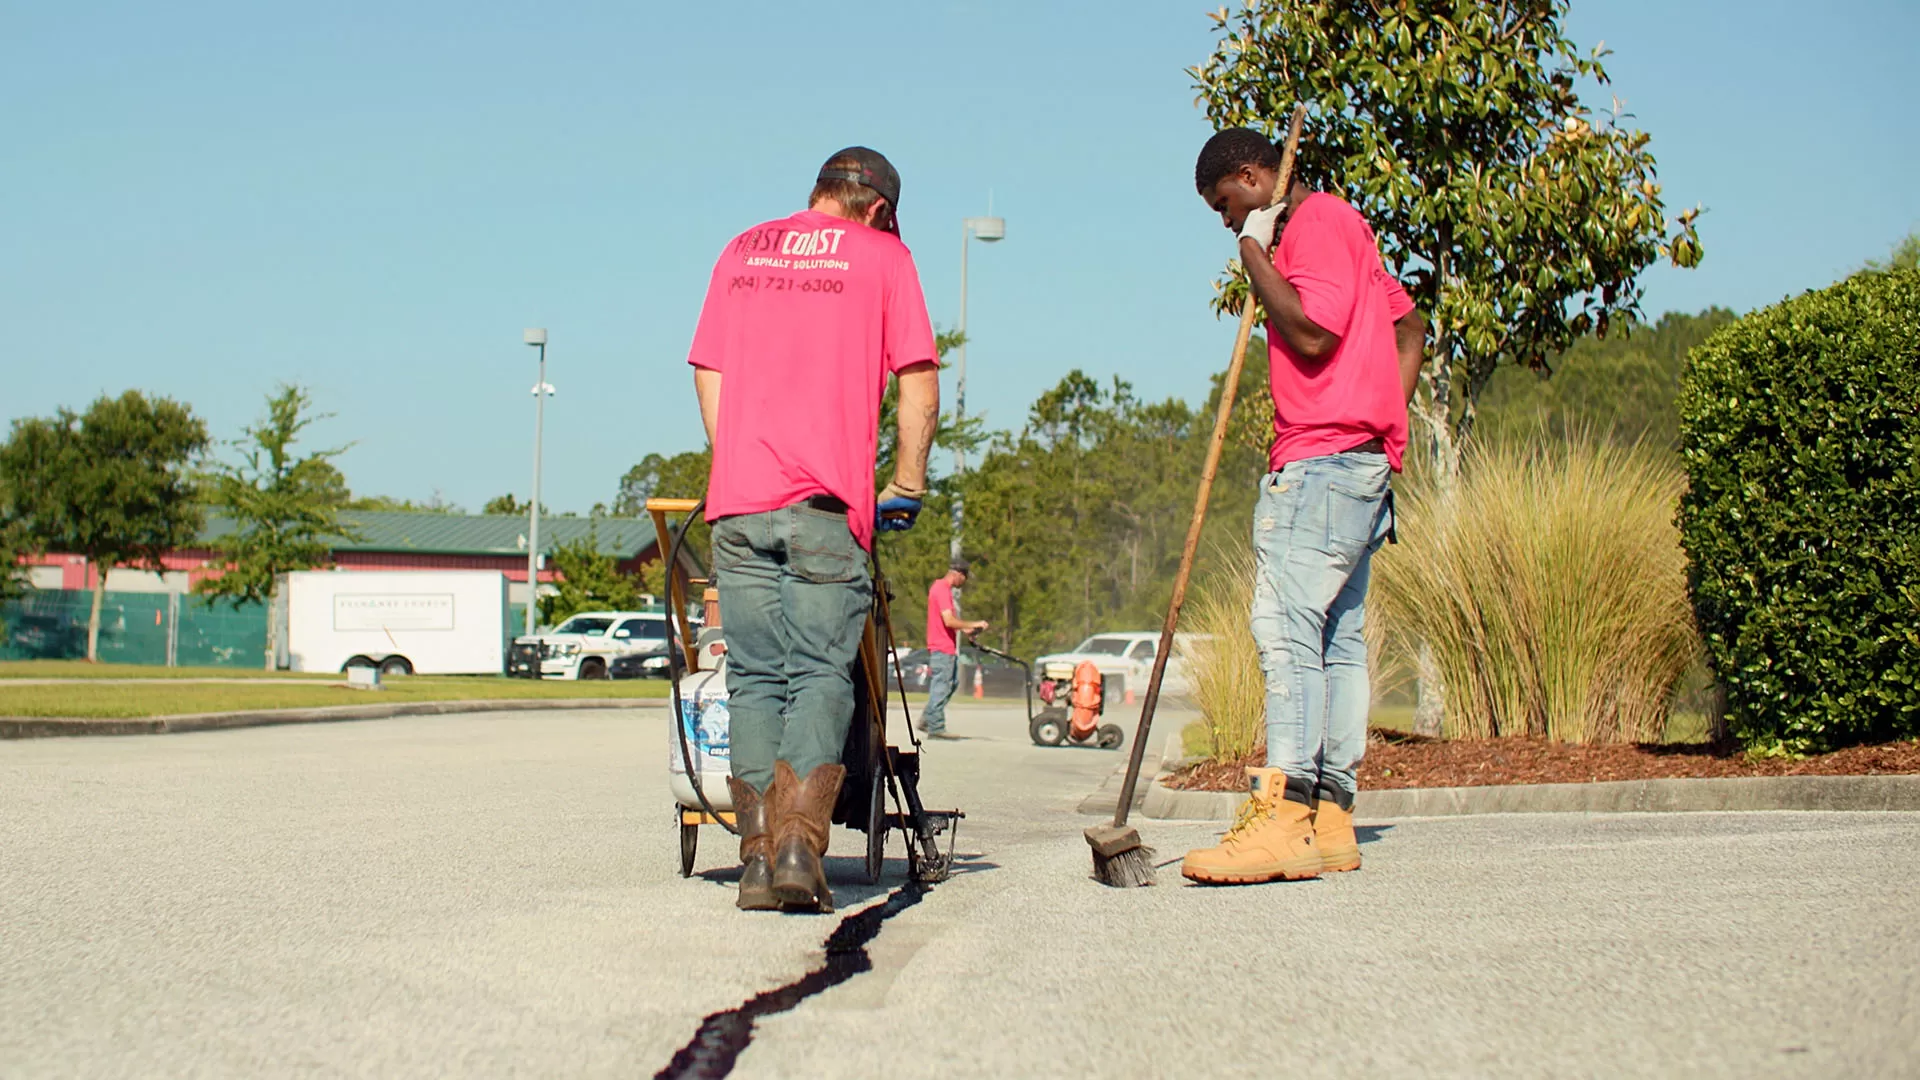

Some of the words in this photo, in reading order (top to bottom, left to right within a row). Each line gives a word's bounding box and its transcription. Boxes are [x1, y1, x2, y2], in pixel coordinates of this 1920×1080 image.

[782, 228, 845, 256] COAST
[747, 256, 791, 268] ASPHALT
[793, 259, 849, 270] SOLUTIONS
[764, 277, 844, 294] 721-6300
